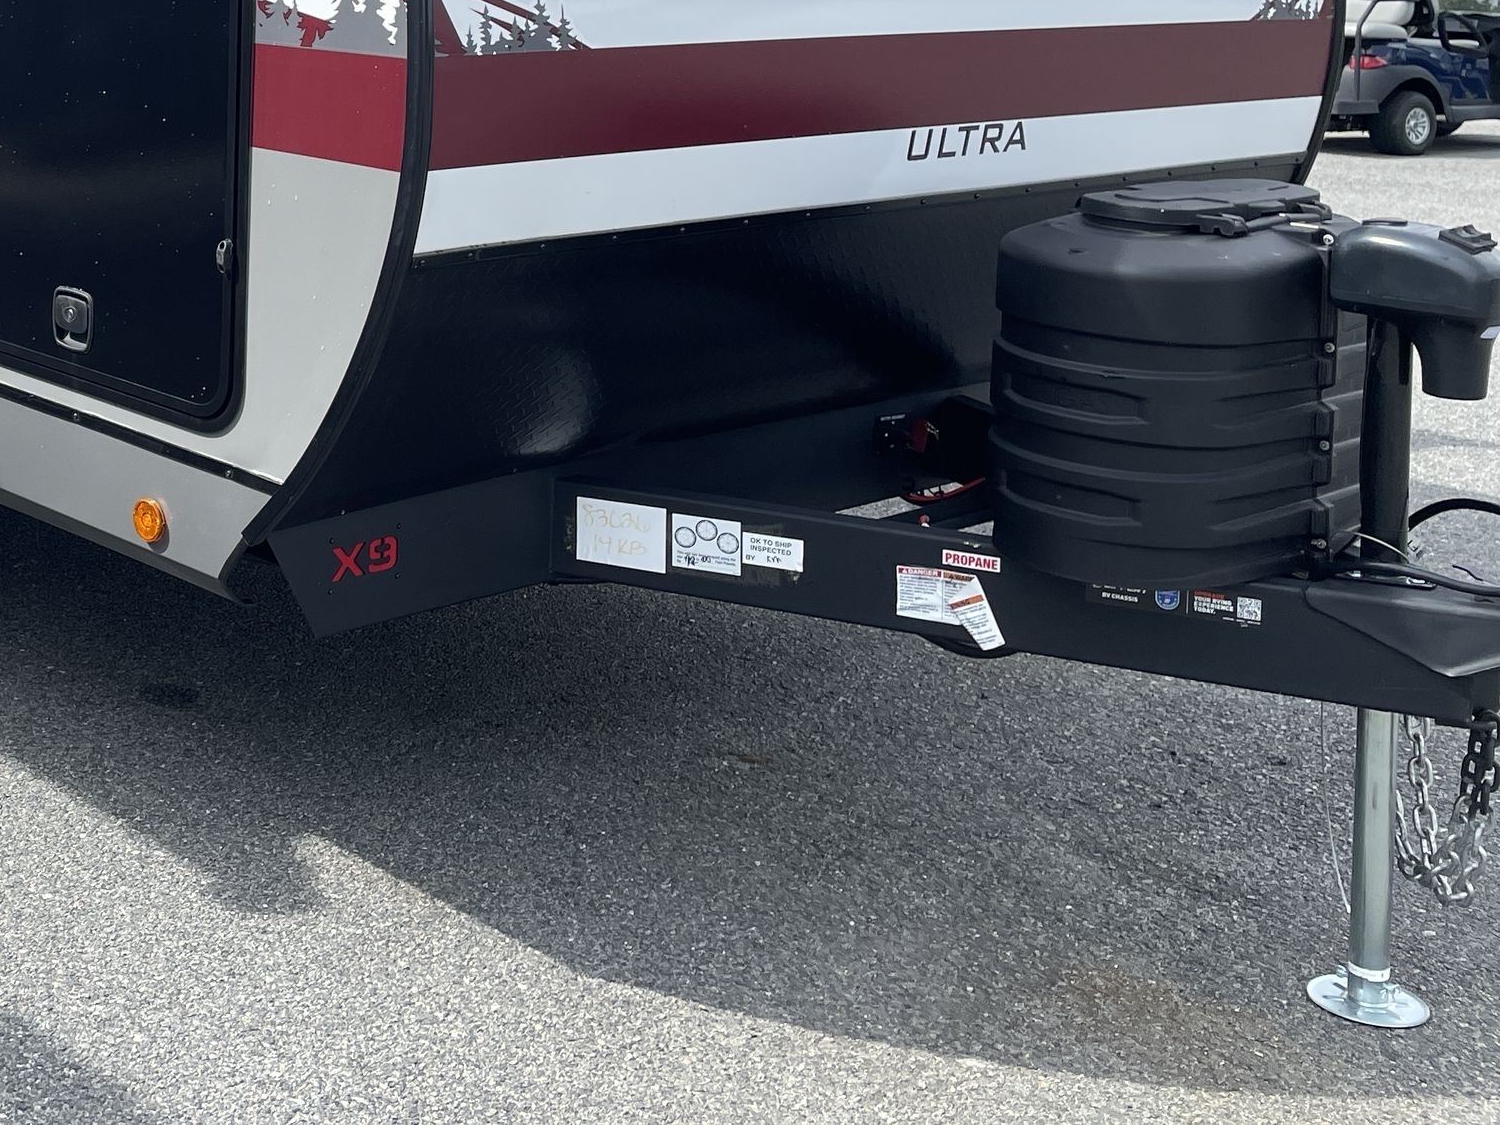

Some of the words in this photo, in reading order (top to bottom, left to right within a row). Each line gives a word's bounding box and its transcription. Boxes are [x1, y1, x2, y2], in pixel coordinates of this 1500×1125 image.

[907, 121, 1026, 162] ULTRA
[750, 544, 792, 557] INSPECTED
[763, 539, 774, 547] TO
[774, 541, 792, 549] SHIP
[331, 535, 399, 584] X9
[945, 552, 998, 570] PROPANE
[1111, 593, 1139, 604] CHASSIS
